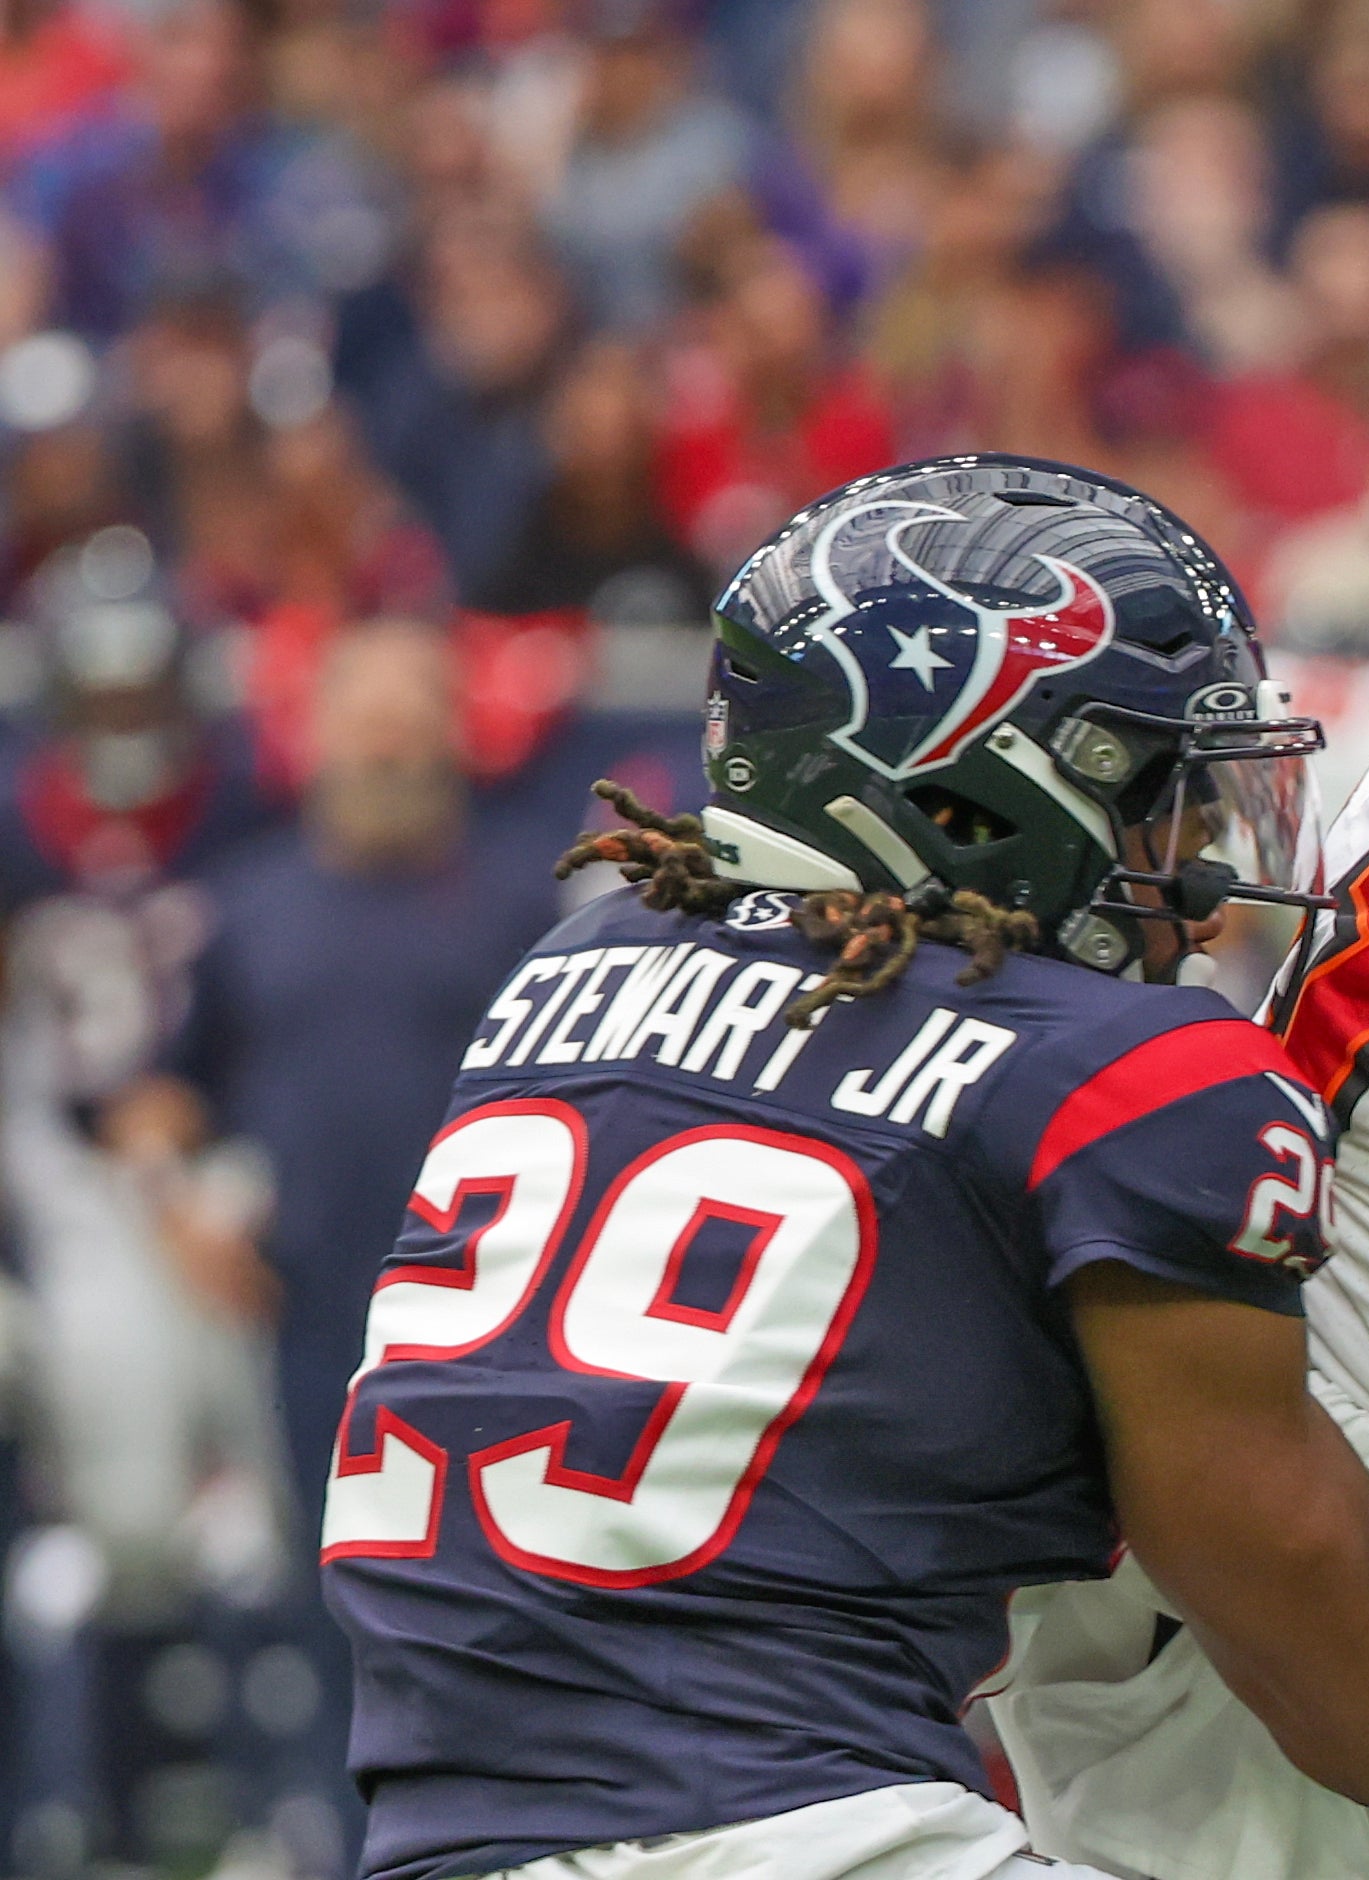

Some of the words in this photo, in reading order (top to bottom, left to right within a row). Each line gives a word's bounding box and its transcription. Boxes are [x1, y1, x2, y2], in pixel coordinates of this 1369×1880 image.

[460, 942, 856, 1091] STEWART
[830, 1008, 1017, 1138] JR
[321, 1098, 878, 1588] 29
